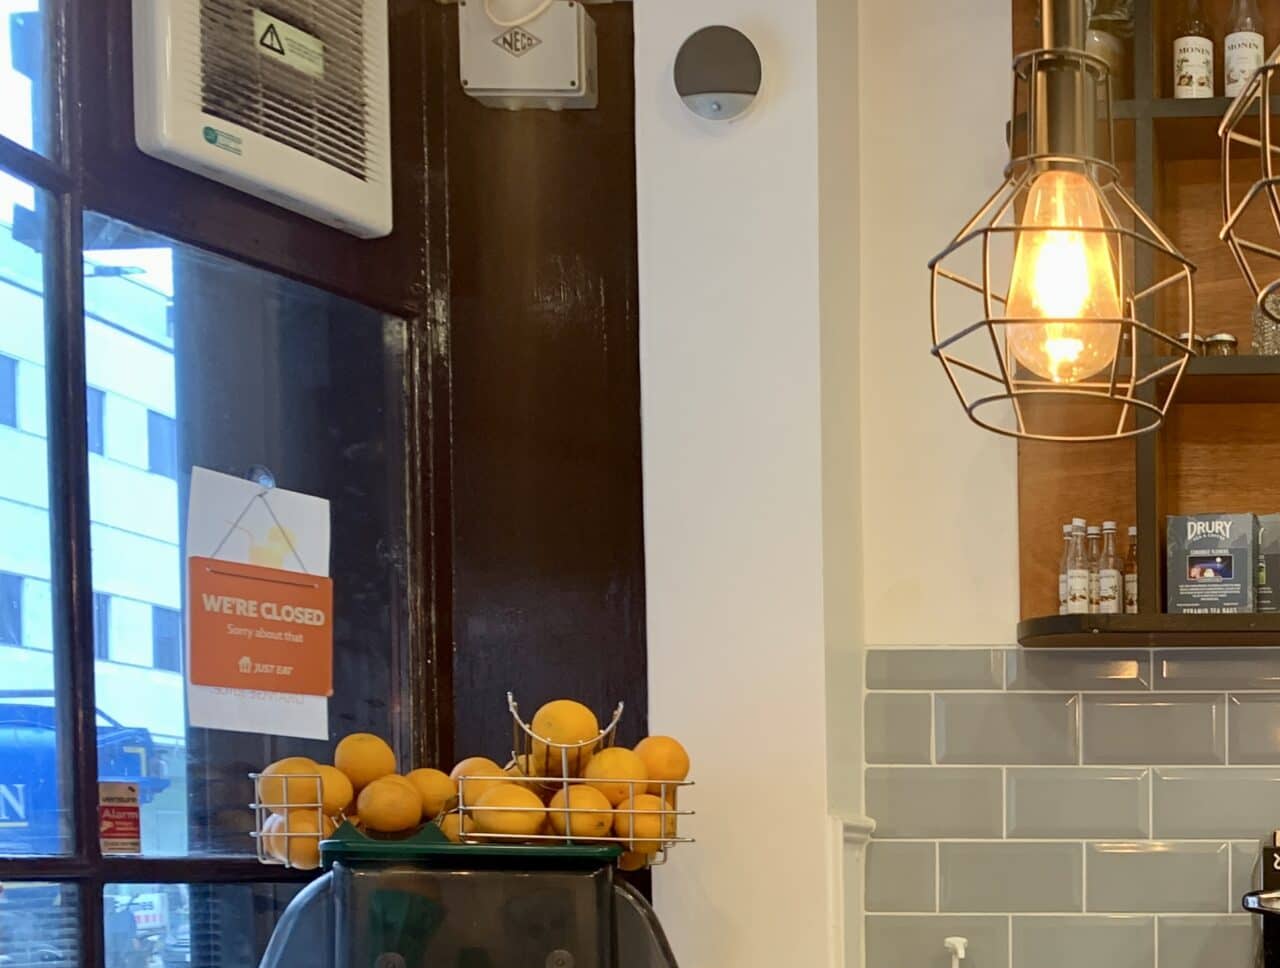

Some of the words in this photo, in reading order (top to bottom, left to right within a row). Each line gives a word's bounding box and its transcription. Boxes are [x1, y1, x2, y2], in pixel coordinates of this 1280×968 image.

[1187, 521, 1233, 540] DRURY
[202, 593, 258, 618] WE'RE
[260, 602, 325, 626] CLOSED
[227, 623, 253, 640] Sorry
[255, 628, 283, 641] about
[284, 631, 304, 643] that
[254, 663, 275, 674] JUST
[276, 666, 294, 675] EAT
[102, 808, 139, 819] Alarm
